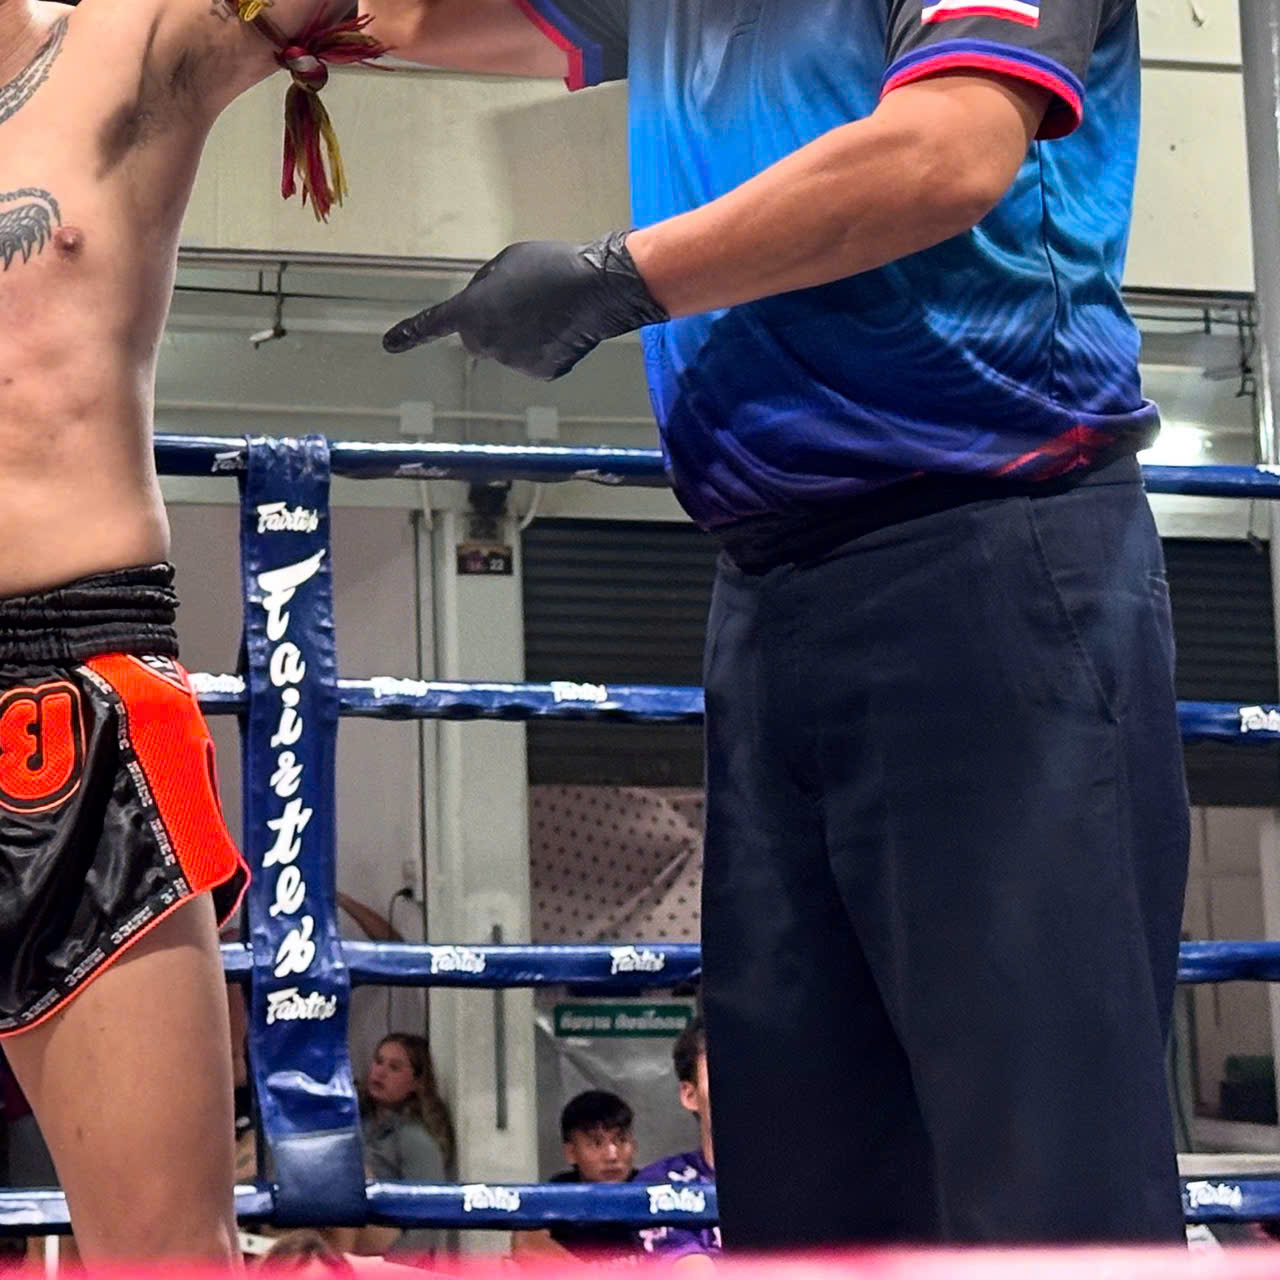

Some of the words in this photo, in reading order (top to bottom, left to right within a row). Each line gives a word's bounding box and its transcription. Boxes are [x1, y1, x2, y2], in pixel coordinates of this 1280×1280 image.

[257, 502, 319, 534] Fairtex
[257, 548, 326, 979] Fairtex
[266, 986, 337, 1025] Fairtex
